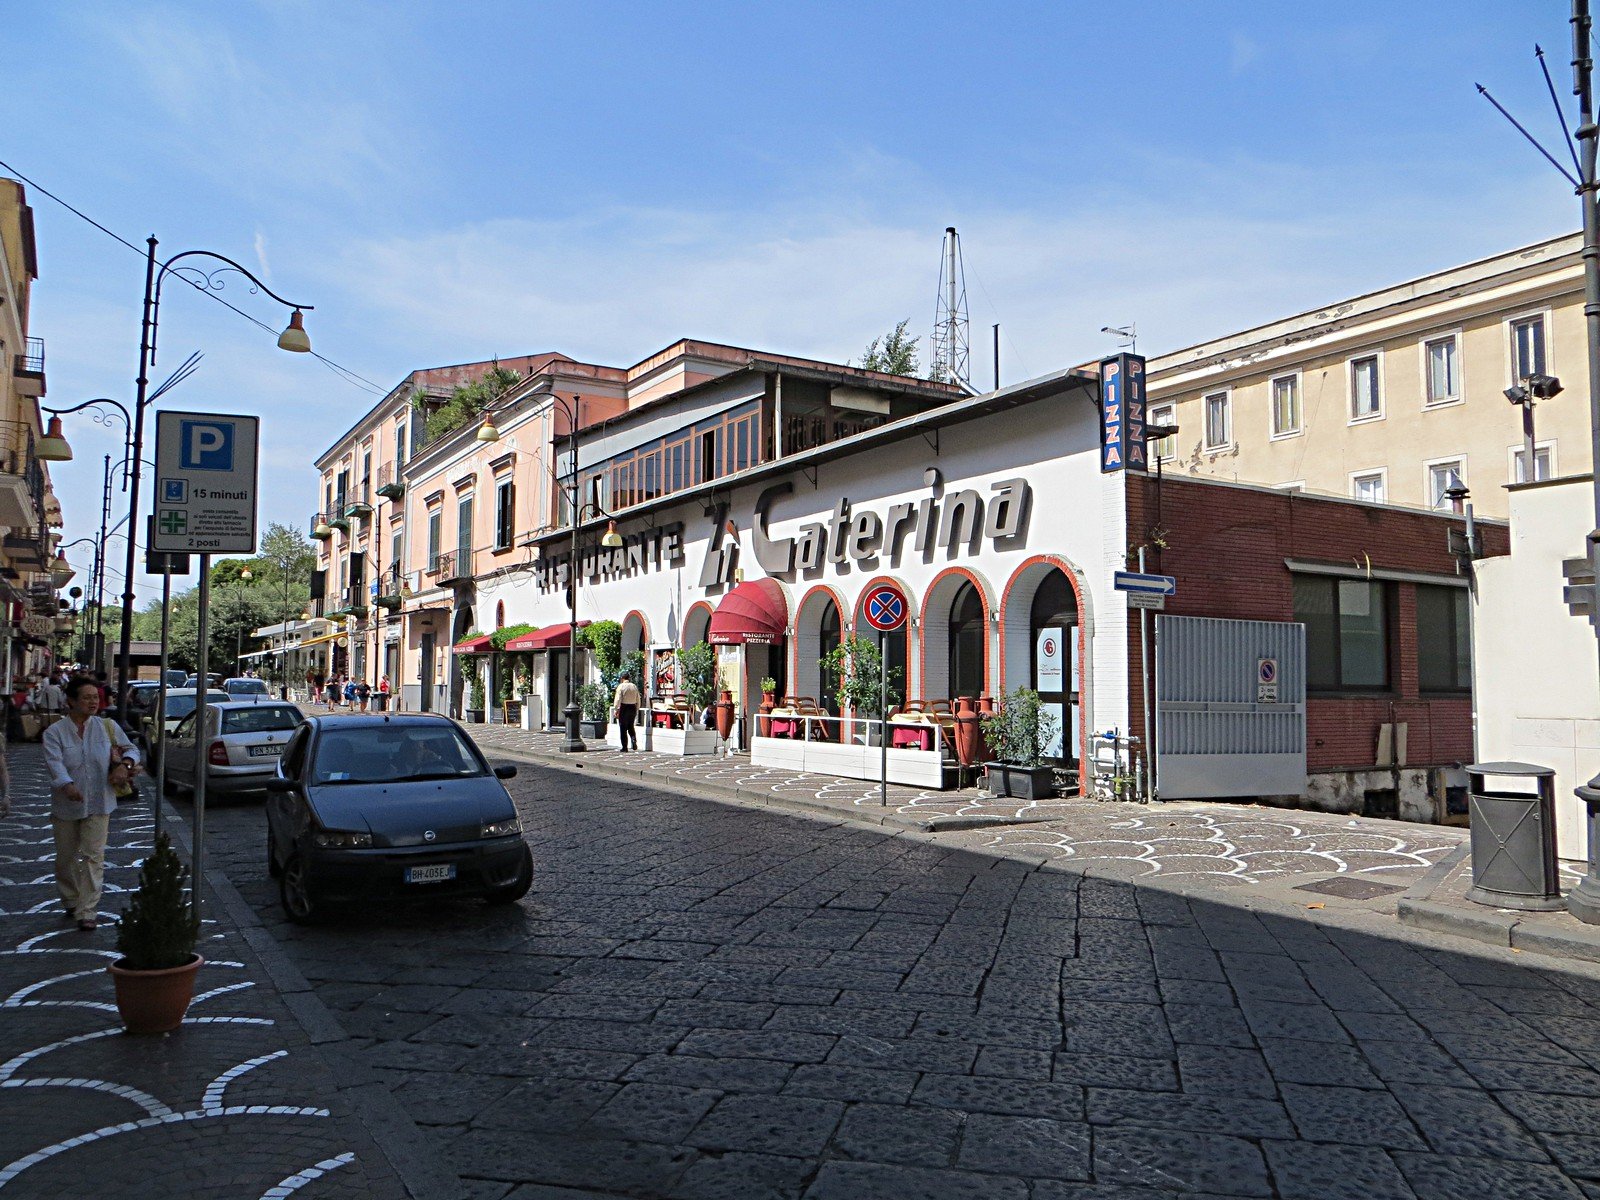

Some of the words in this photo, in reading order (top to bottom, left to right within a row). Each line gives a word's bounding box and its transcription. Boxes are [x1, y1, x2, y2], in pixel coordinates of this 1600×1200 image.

[190, 425, 225, 464] P
[1105, 363, 1121, 465] PIZZA
[1128, 361, 1144, 463] PIZZA
[193, 489, 207, 499] 15
[210, 490, 248, 500] minuti
[752, 467, 1029, 573] Caterina
[188, 538, 194, 546] 2
[196, 539, 220, 548] posti
